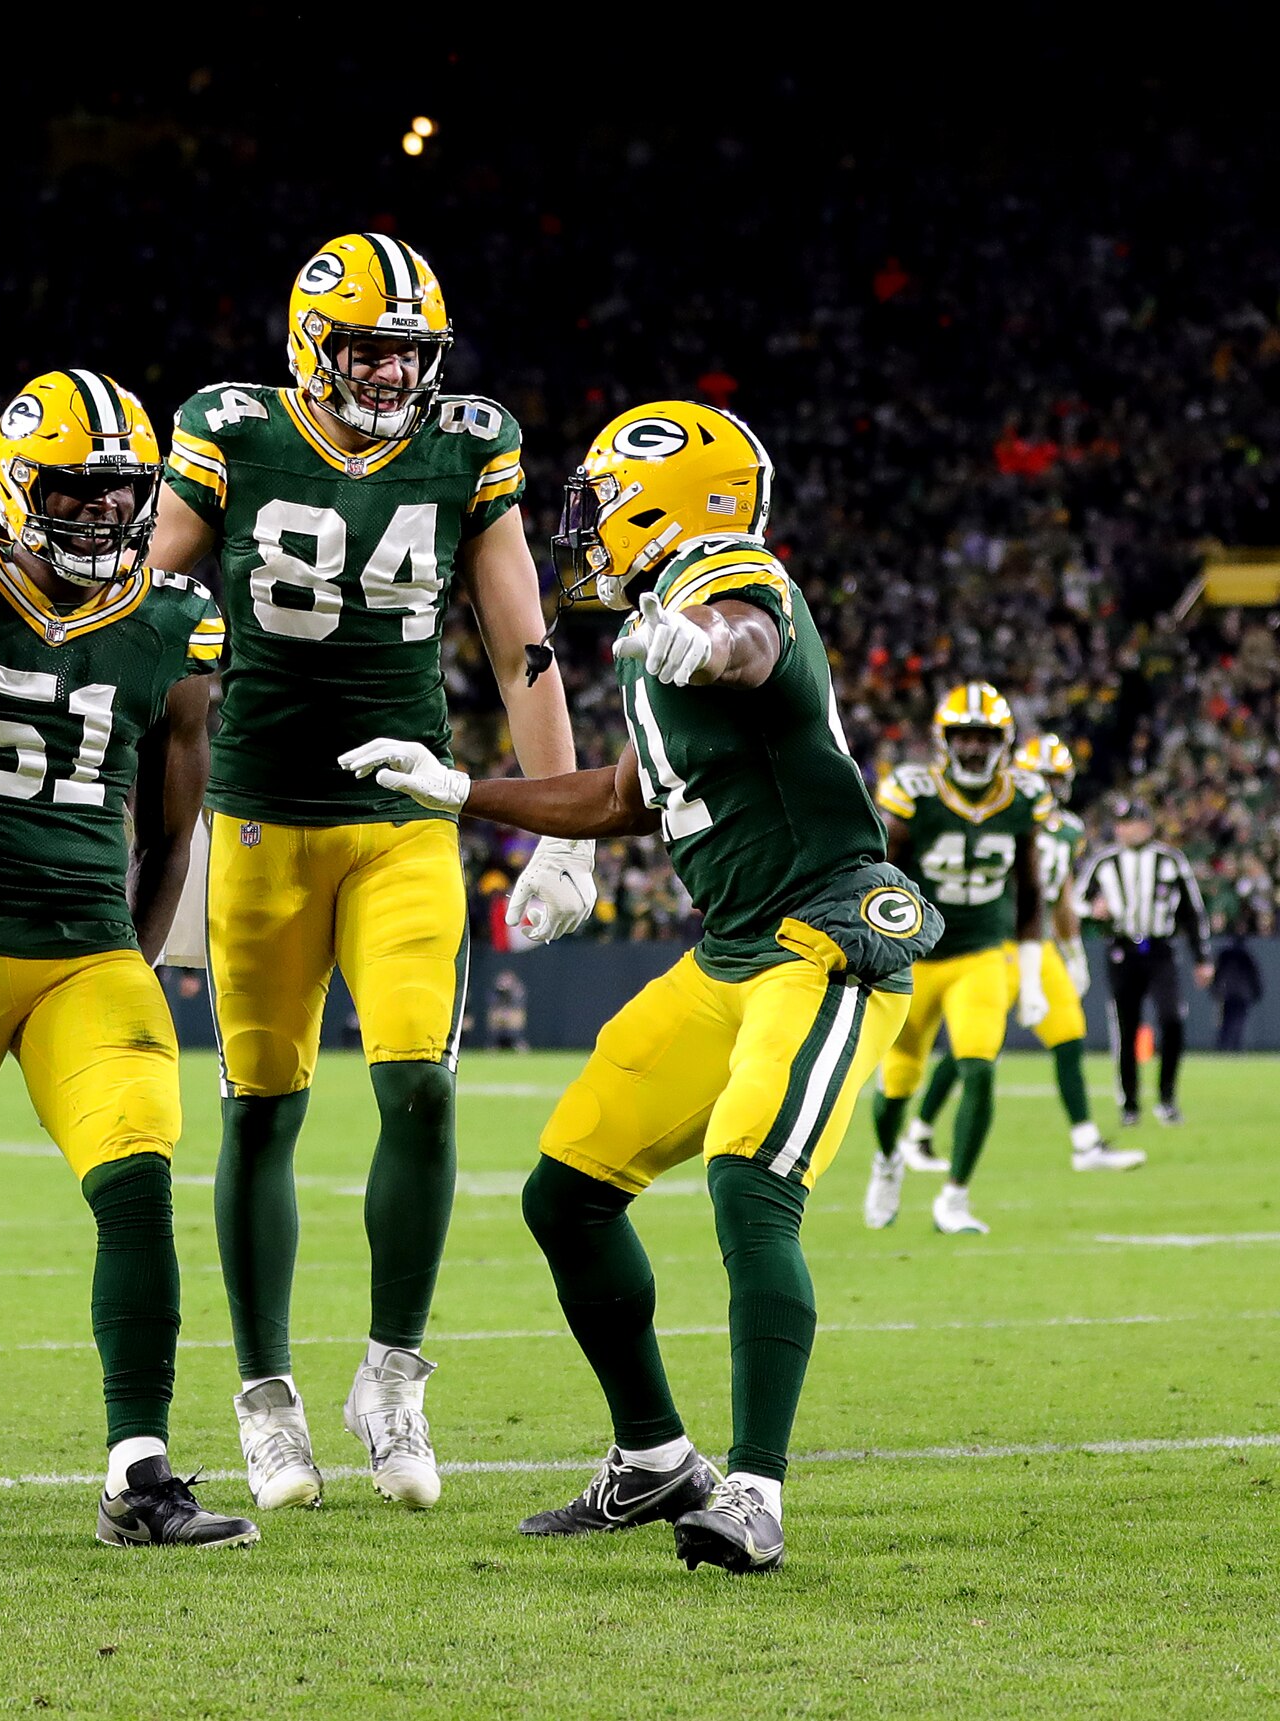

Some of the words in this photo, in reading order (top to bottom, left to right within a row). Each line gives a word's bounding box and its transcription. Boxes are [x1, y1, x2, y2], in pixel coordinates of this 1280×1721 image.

[298, 252, 345, 294] G
[391, 317, 419, 328] PACKERS
[99, 454, 128, 464] PACKERS
[613, 417, 688, 459] G
[250, 498, 445, 642] 84
[920, 832, 1016, 906] 42
[867, 892, 918, 933] G
